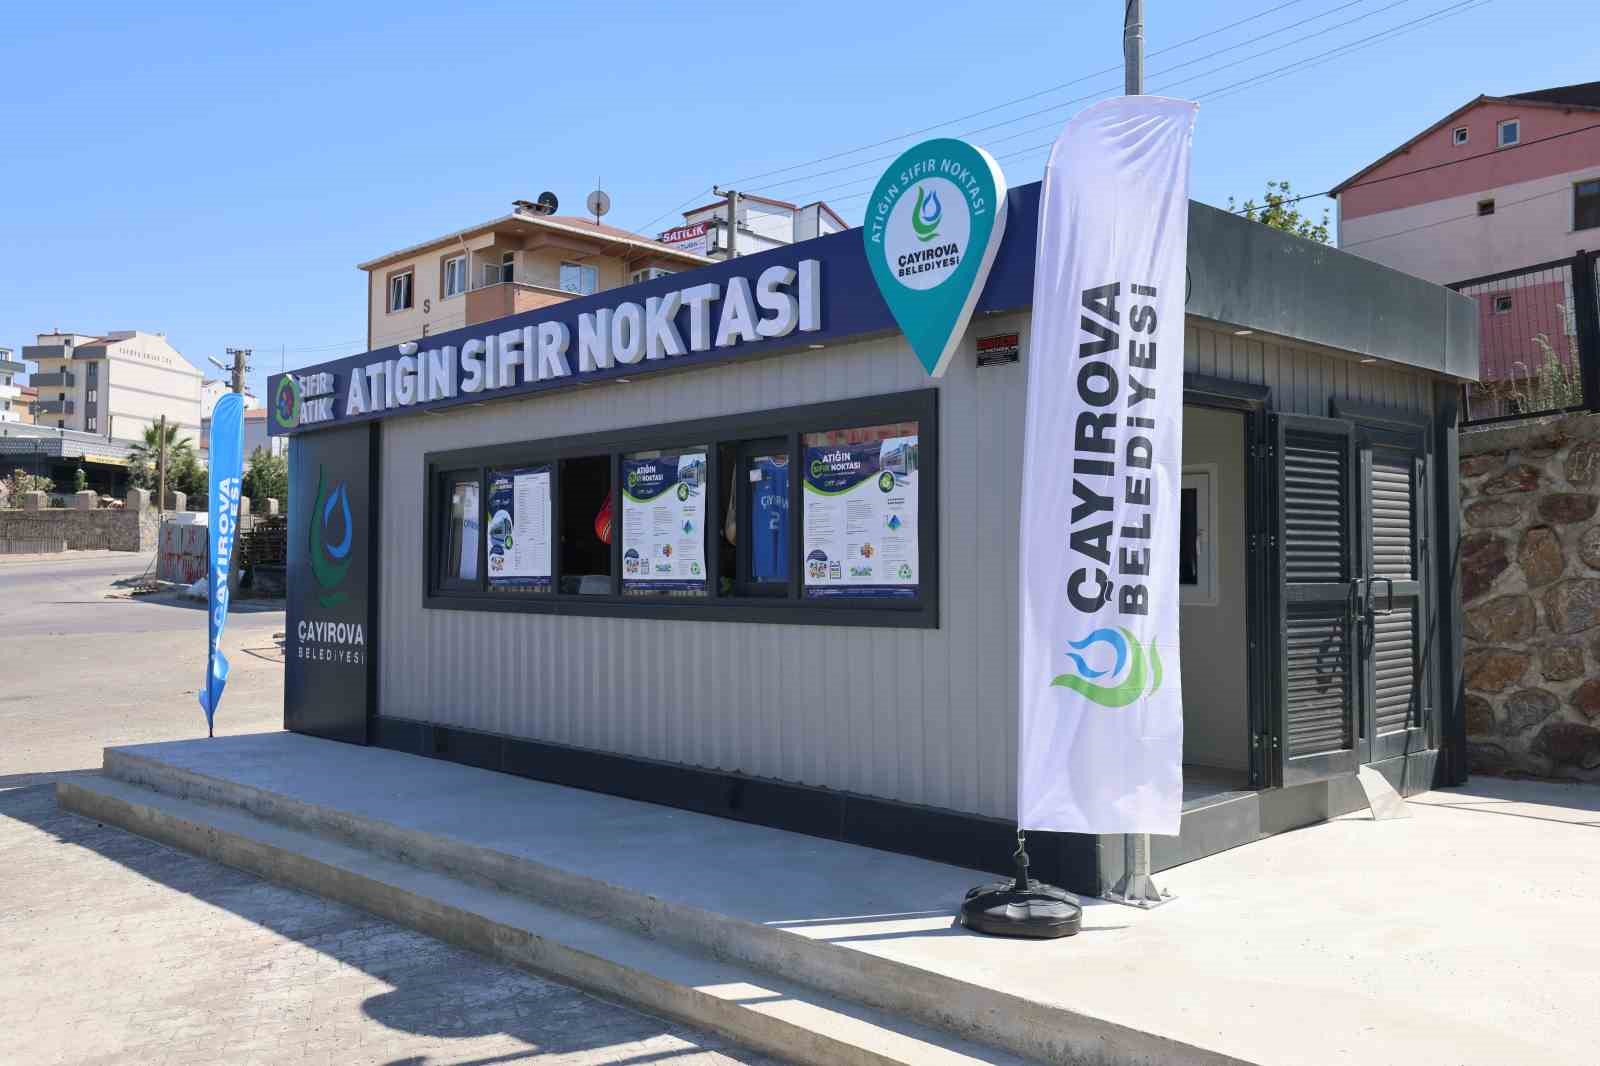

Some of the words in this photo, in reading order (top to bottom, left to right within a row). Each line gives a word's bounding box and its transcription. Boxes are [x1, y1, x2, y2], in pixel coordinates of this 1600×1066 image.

[900, 159, 936, 185] SIFIR
[941, 159, 985, 216] NOKTASI
[898, 255, 960, 277] BELEDİYESİ
[346, 342, 457, 416] ATIĞIN
[461, 321, 571, 393] SIFIR
[578, 259, 821, 372] NOKTASI
[299, 372, 335, 397] SIFIR
[300, 397, 335, 424] ATIK
[1066, 281, 1121, 614] ÇAYIROVA
[1118, 283, 1158, 616] BELEDİYESİ
[298, 620, 364, 645] ÇAYIROVA
[298, 646, 364, 664] BELEDİYESİ
